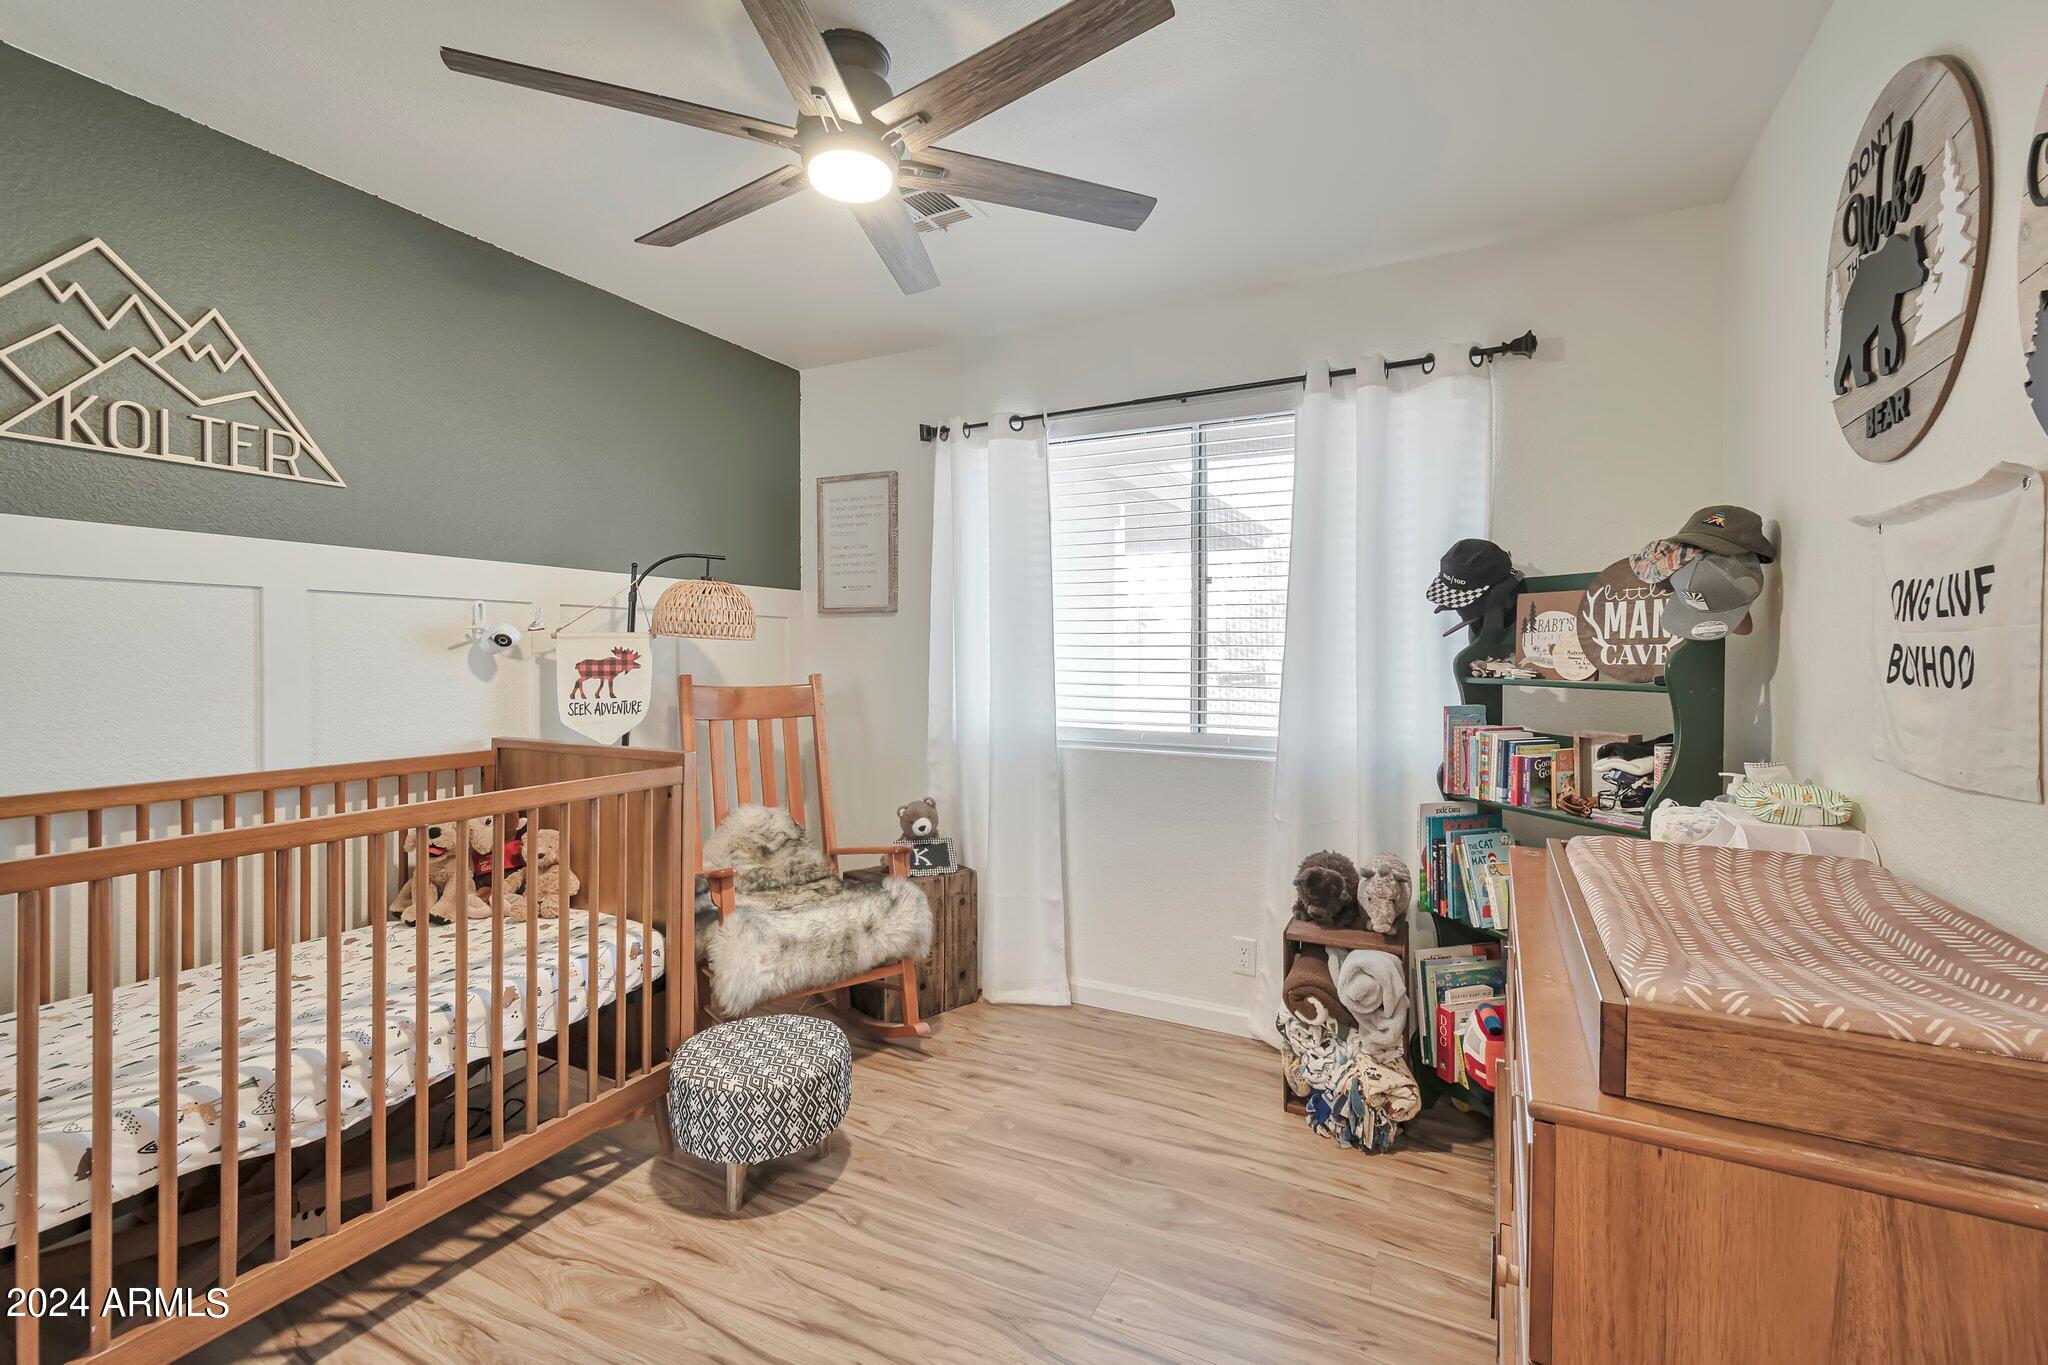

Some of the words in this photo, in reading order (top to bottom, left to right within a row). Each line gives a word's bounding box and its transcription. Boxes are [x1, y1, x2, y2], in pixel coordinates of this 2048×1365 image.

[1849, 111, 1894, 193] DON'T
[1842, 120, 1926, 254] Wake
[1847, 256, 1861, 282] TH
[1866, 387, 1909, 438] BEAR
[62, 391, 301, 478] KOLTER
[1605, 583, 1674, 601] little
[1891, 578, 1934, 622] ONG
[1537, 617, 1576, 633] BABY'S
[1600, 644, 1667, 665] CAVE
[568, 702, 592, 716] SEEK
[594, 700, 642, 716] ADVENTURE
[1478, 838, 1494, 849] CAT
[914, 847, 932, 866] K
